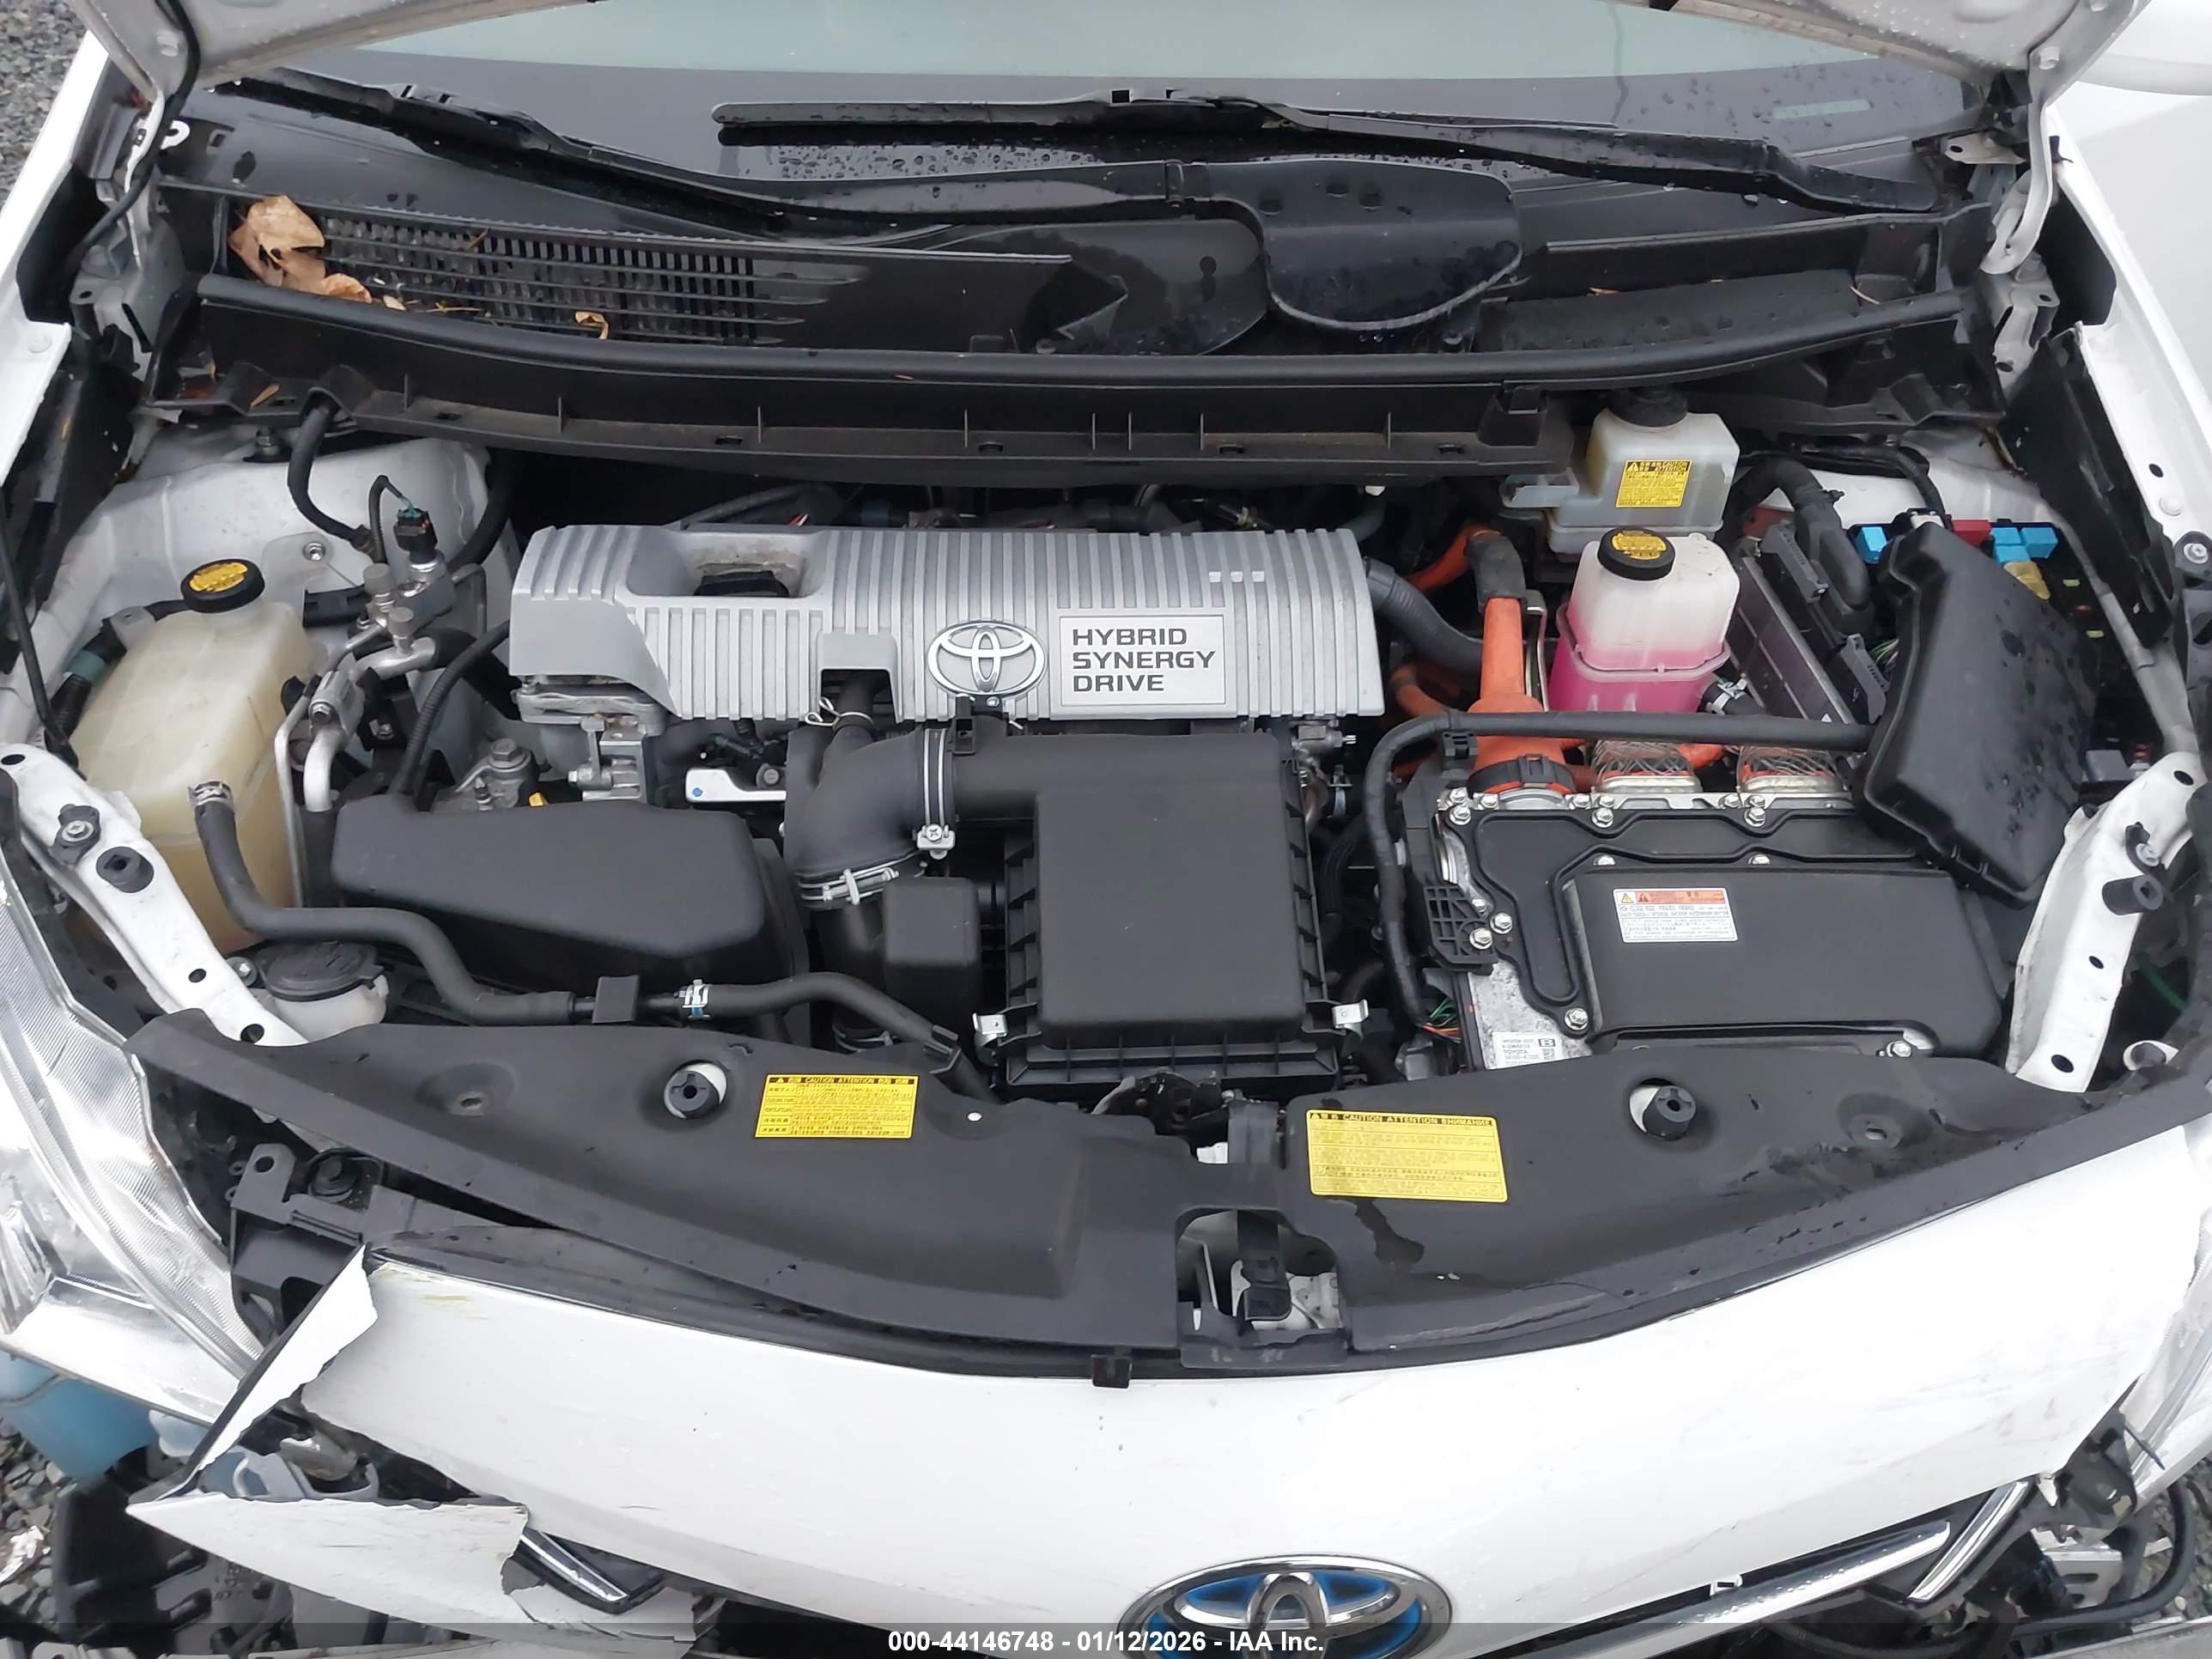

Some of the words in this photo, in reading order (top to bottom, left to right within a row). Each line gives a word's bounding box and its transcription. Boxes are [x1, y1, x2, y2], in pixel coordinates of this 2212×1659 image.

[1073, 628, 1188, 646] HYBRID
[1073, 650, 1216, 670] SYNERGY
[1073, 674, 1164, 692] DRIVE
[1343, 1113, 1382, 1122] CAUTION
[1387, 1115, 1438, 1124] ATTENTION
